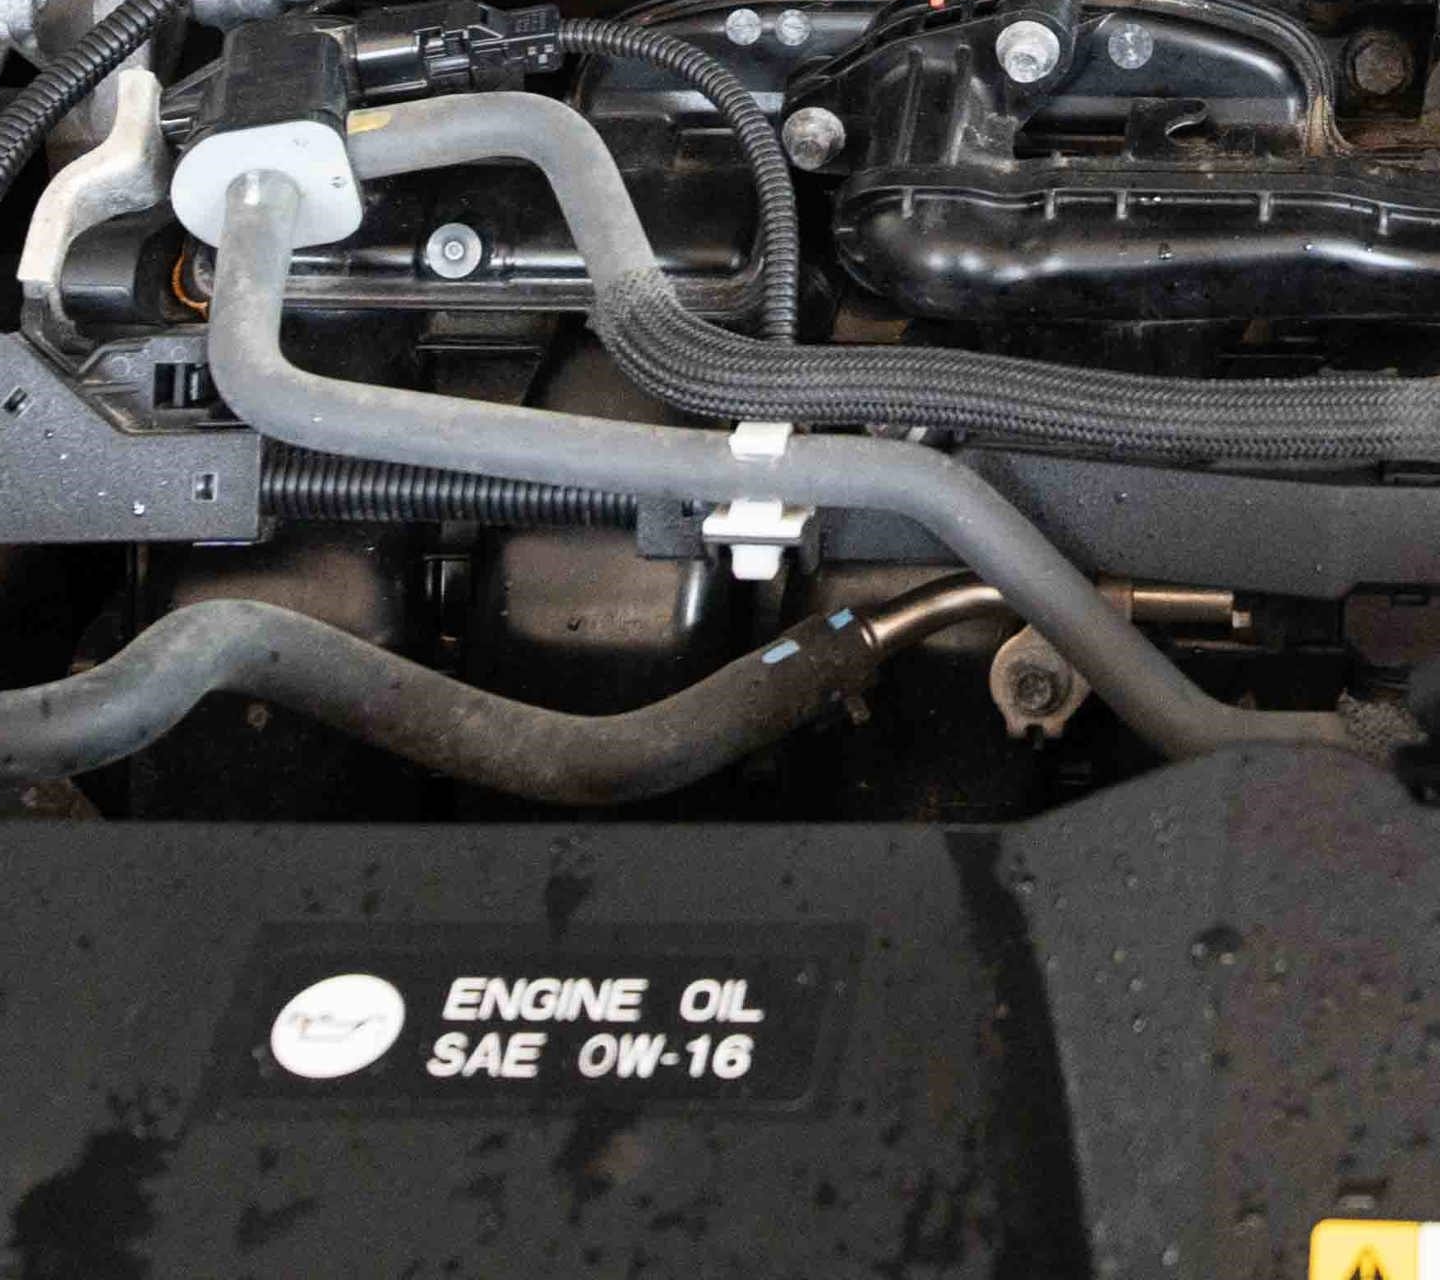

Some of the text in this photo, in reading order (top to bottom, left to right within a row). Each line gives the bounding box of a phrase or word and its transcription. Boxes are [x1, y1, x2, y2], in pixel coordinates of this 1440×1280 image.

[442, 976, 765, 1024] ENGINE OIL
[426, 1032, 548, 1079] SAE
